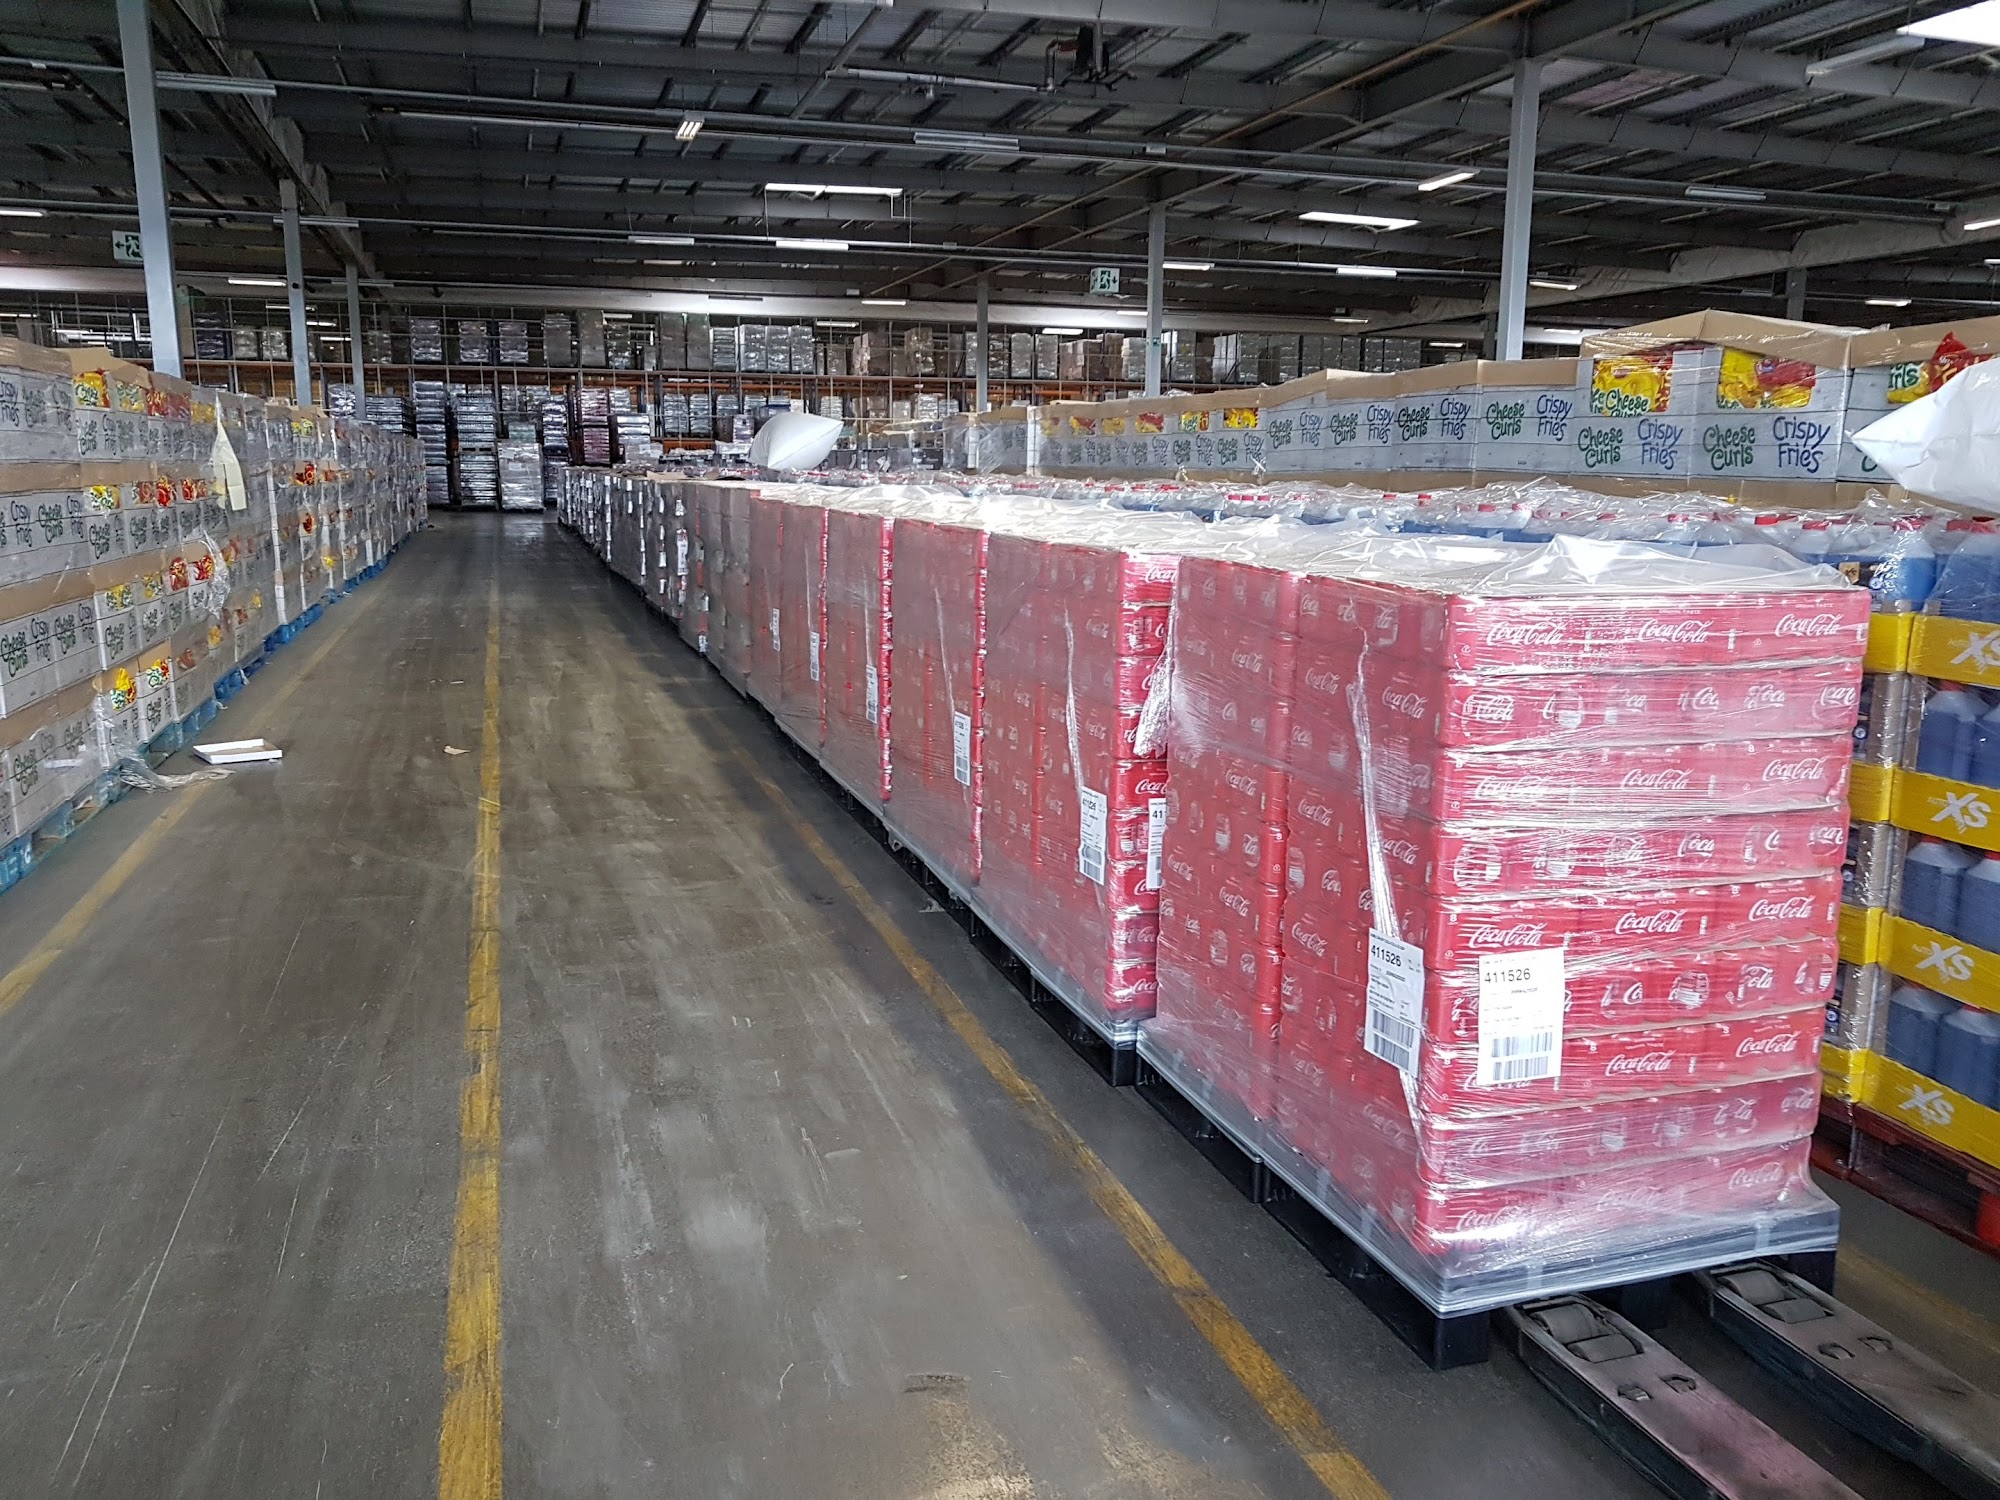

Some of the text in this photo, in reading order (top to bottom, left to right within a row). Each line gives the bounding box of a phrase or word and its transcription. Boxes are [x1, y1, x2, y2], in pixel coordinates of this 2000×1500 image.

[1440, 398, 1471, 422] Crispy
[1486, 401, 1525, 425] Cheese
[1537, 394, 1573, 422] Crispy
[1606, 389, 1649, 412] Cheese
[1367, 405, 1394, 427] Crispy
[1398, 406, 1430, 428] Cheese
[1537, 416, 1567, 441] Fries
[1368, 424, 1391, 444] Fries
[1402, 421, 1428, 441] Curls
[1441, 419, 1466, 440] Fries
[1491, 418, 1521, 440] Curls
[1578, 426, 1623, 451] Cheese
[1638, 418, 1683, 449] Crispy
[1702, 424, 1756, 453] Cheese
[1773, 416, 1831, 450] Crispy
[1585, 445, 1621, 468] Curls
[1641, 443, 1678, 470] Fries
[1711, 444, 1753, 471] Curls
[1778, 443, 1823, 473] Fries
[1638, 619, 1714, 643] Coca-Cola
[1775, 613, 1844, 637] Coca-Cola
[1382, 686, 1428, 719] Coca-Cola
[1621, 769, 1694, 790] Coca-Cola
[1762, 757, 1827, 782] Coca-Cola
[1930, 791, 1992, 834] XS
[1748, 895, 1816, 922] Coca-Cola
[1614, 908, 1688, 935] Coca-Cola
[1468, 923, 1548, 949] Coca-Cola
[1371, 945, 1402, 967] 411526
[1916, 941, 1974, 984] XS
[1485, 968, 1531, 983] 411526
[1735, 1030, 1801, 1058] Coca-Cola
[1605, 1050, 1676, 1077] Coca-Cola
[1897, 1084, 1955, 1126] XS
